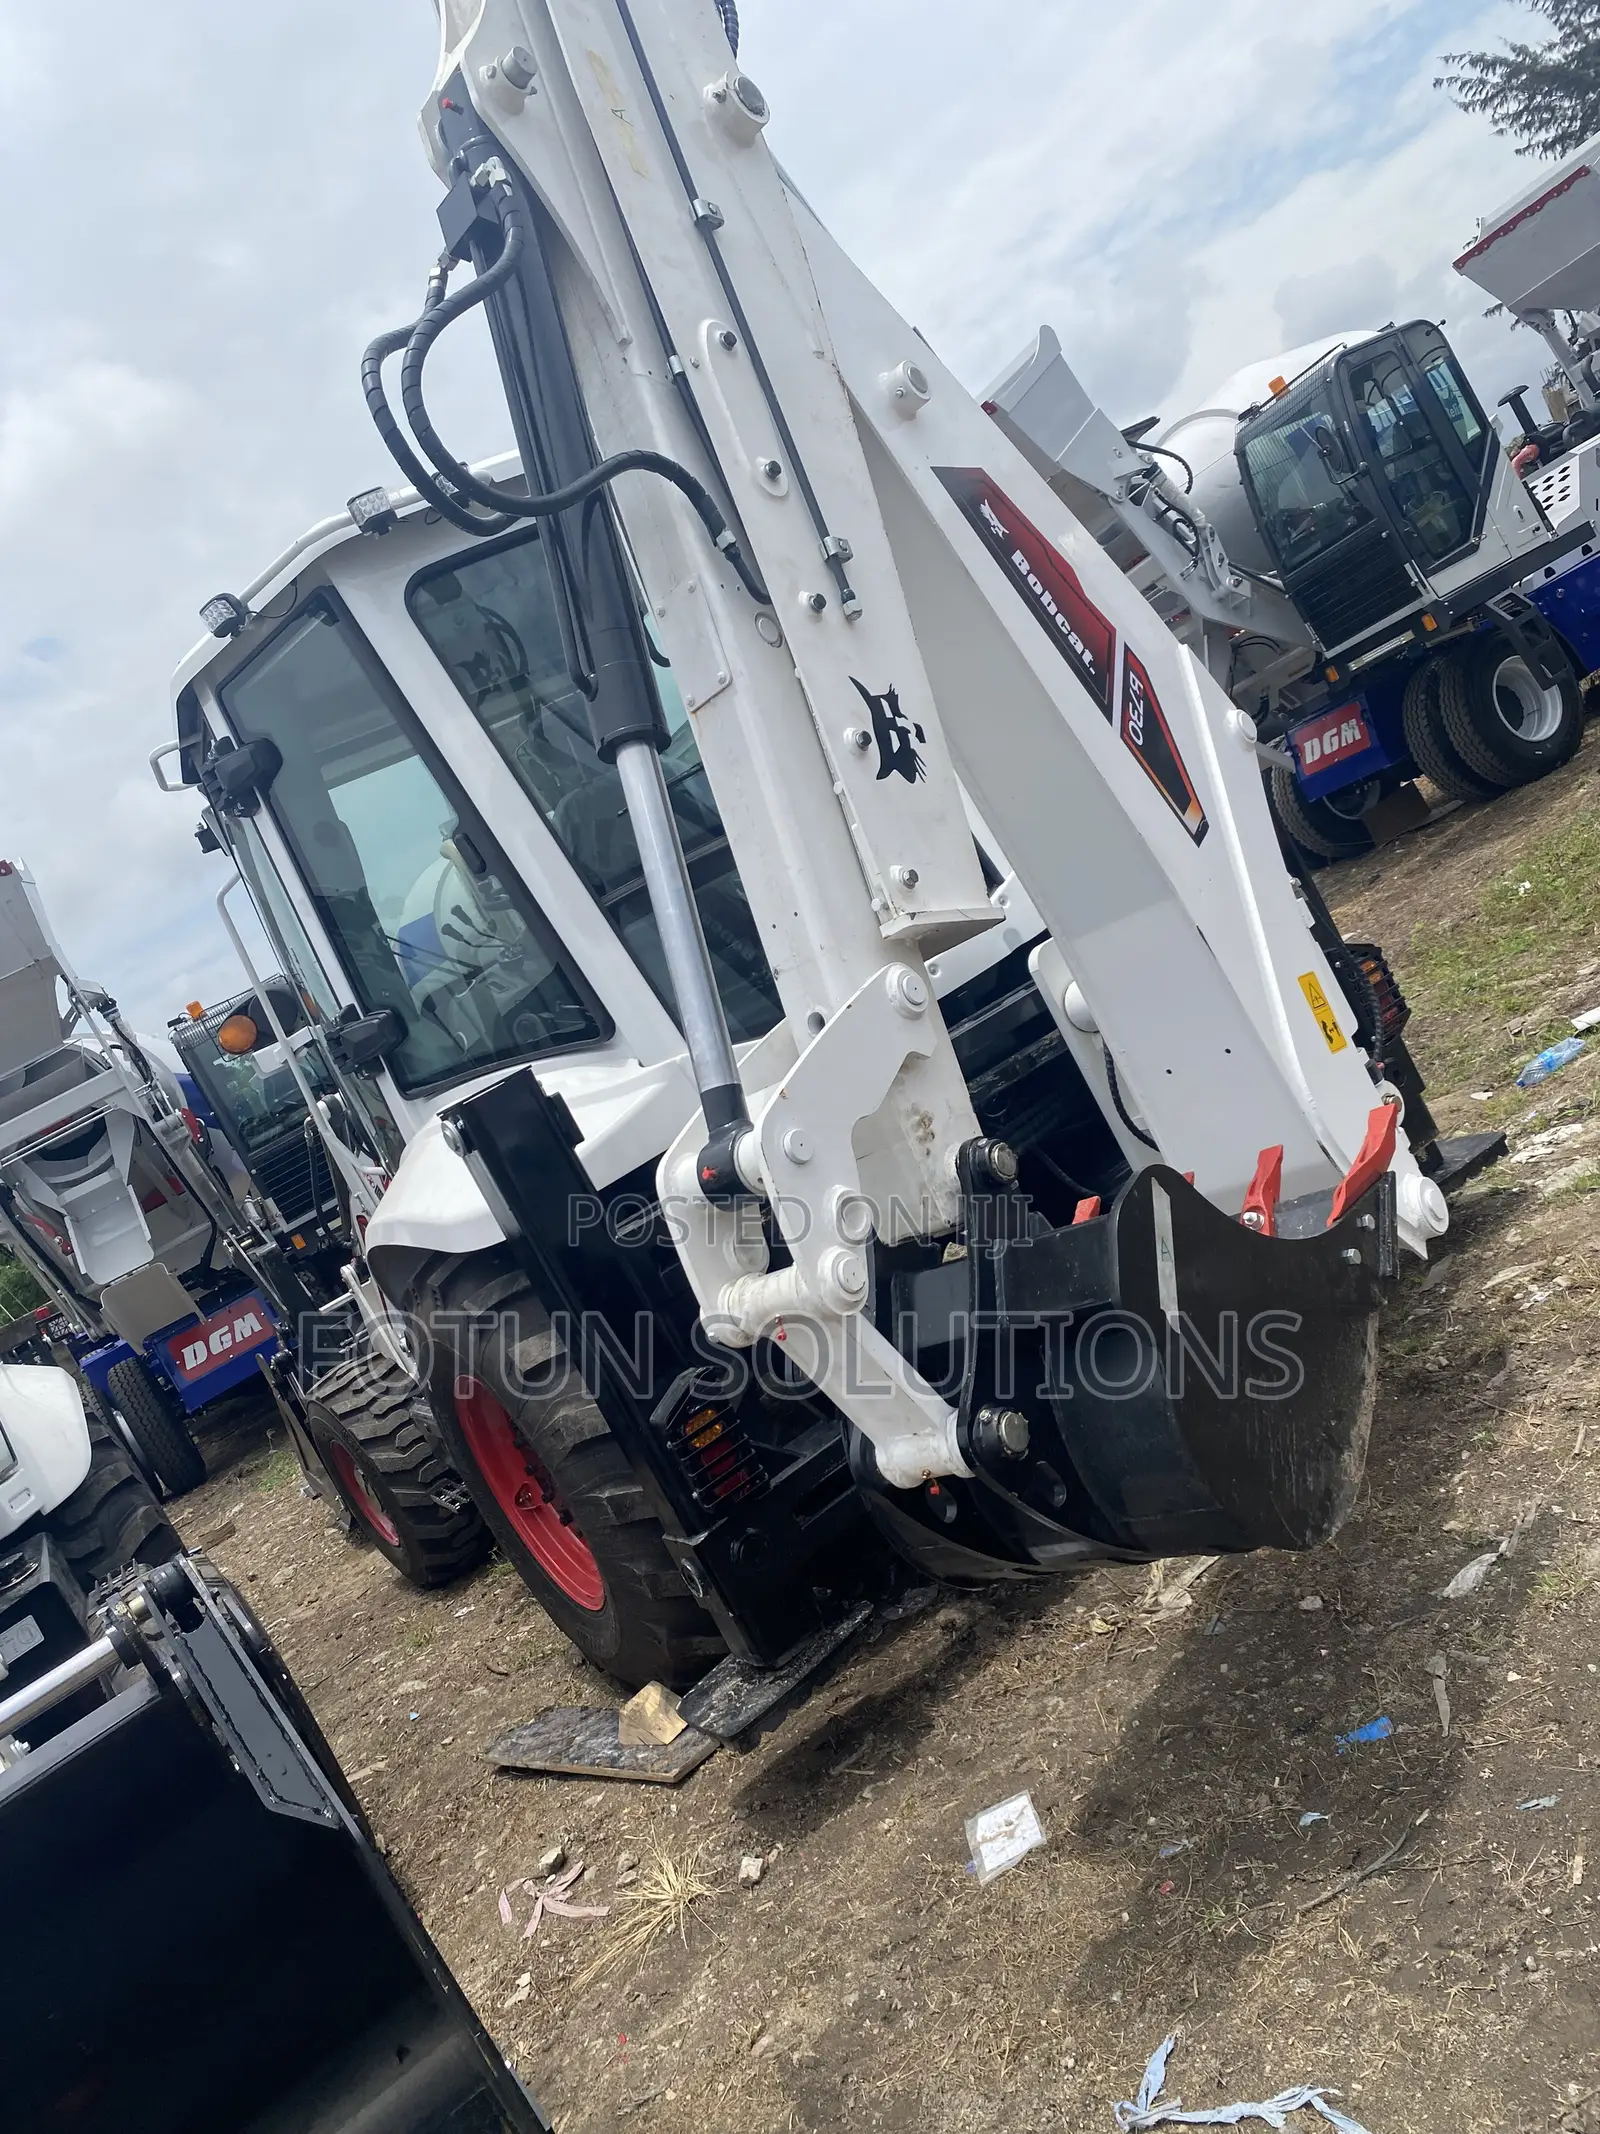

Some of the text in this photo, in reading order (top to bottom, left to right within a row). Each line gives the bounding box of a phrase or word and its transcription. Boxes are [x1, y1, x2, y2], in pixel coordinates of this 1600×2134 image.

[1128, 670, 1144, 746] B730
[1303, 718, 1362, 765] DGM
[1160, 1235, 1174, 1264] A
[181, 1312, 263, 1371] DGM
